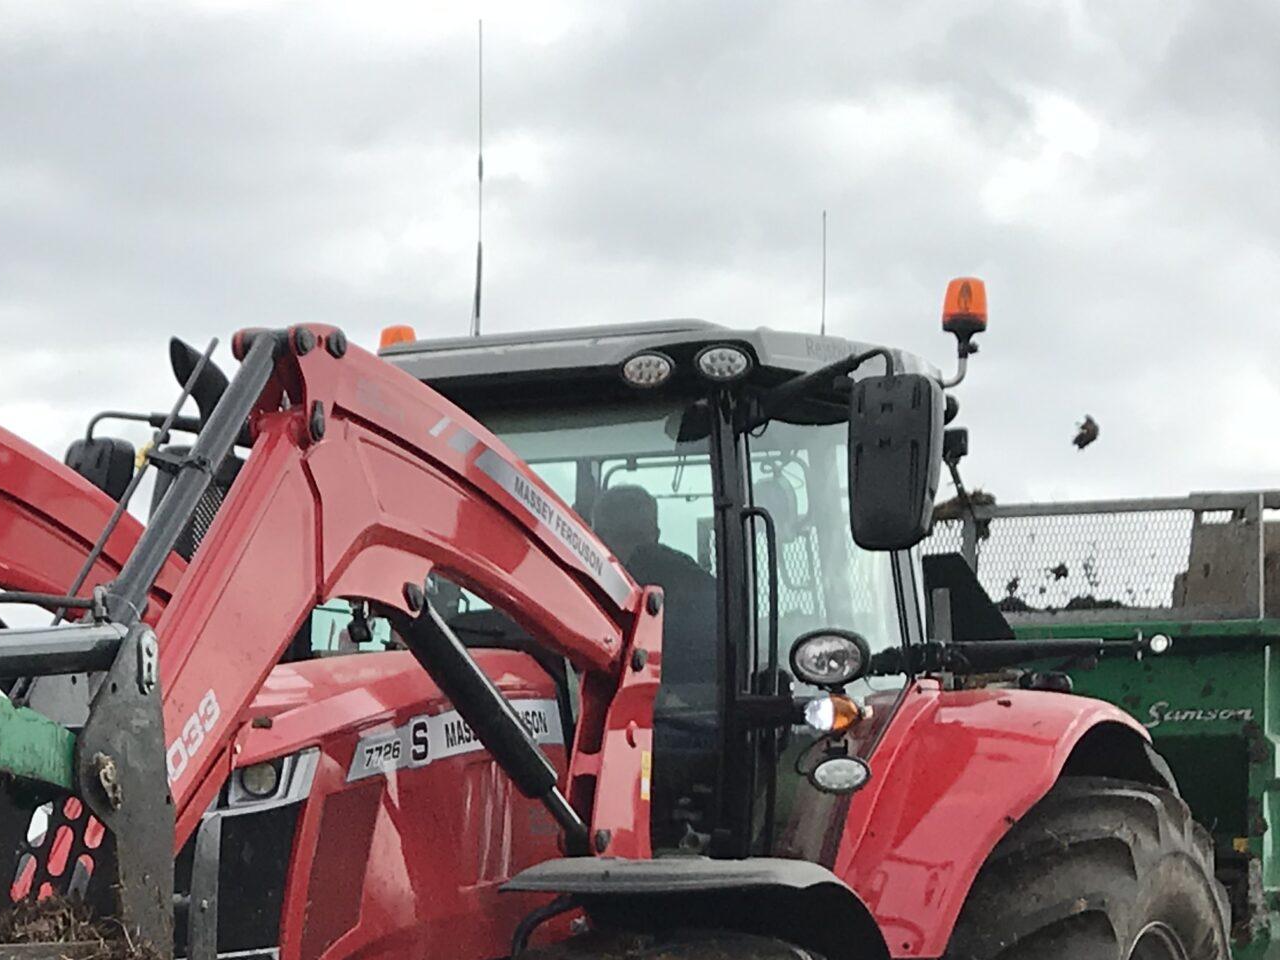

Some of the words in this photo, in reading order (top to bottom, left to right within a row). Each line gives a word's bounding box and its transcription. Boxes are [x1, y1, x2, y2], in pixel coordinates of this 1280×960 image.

[514, 476, 554, 525] MASSEY
[555, 514, 603, 576] FERGUSON
[166, 688, 220, 787] 033
[365, 741, 401, 767] 7726
[412, 721, 429, 761] S
[1143, 701, 1254, 728] Samson
